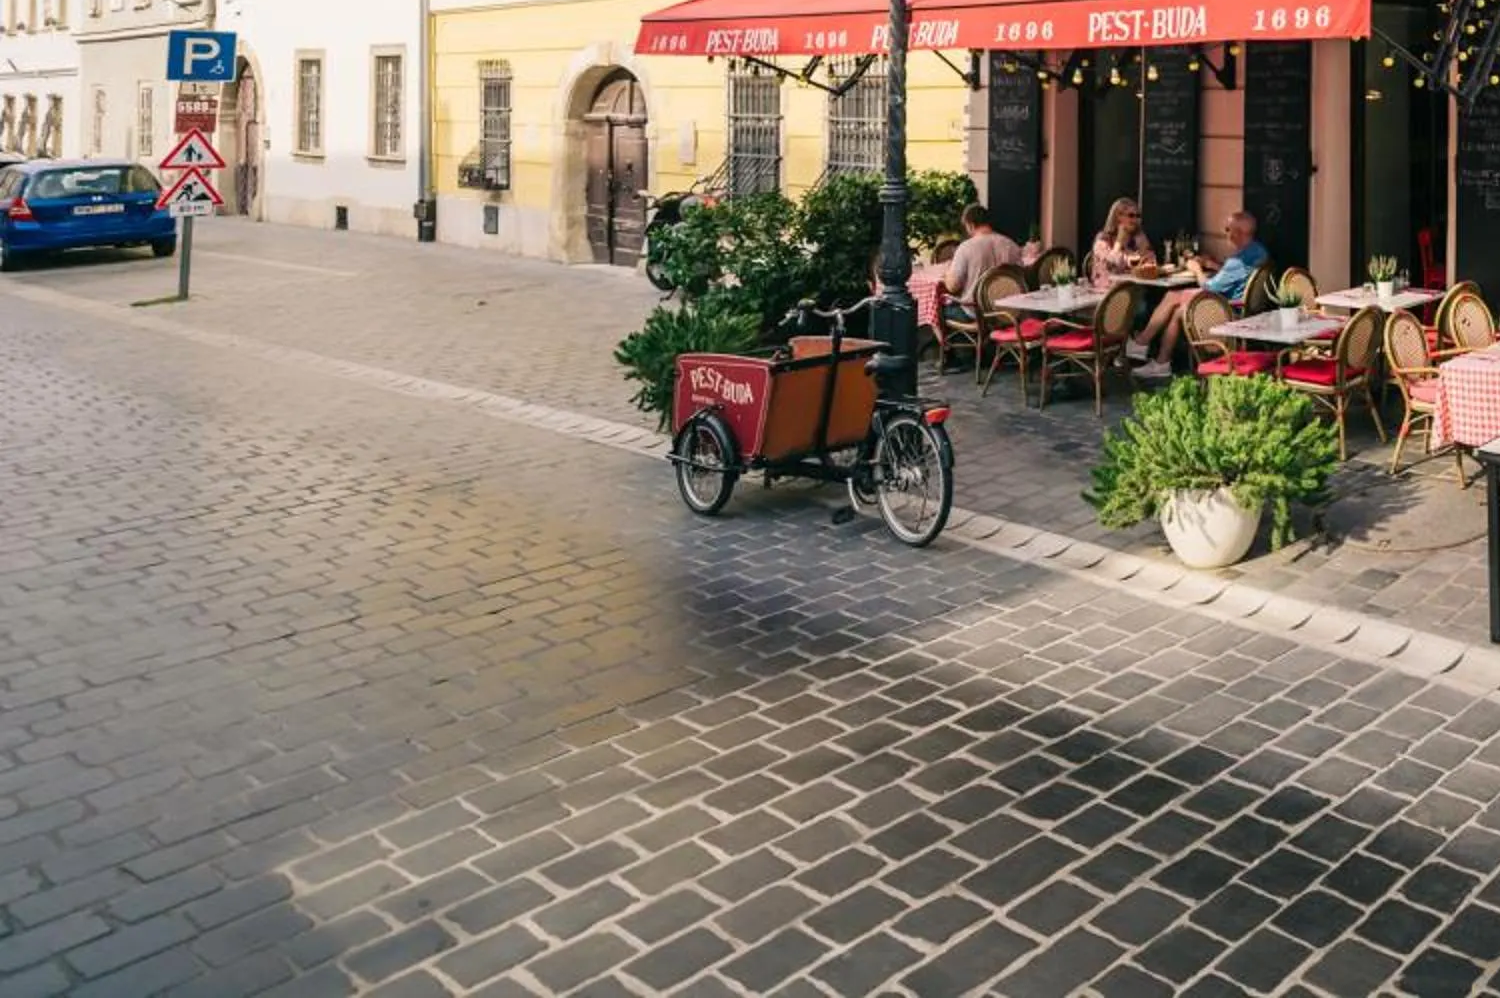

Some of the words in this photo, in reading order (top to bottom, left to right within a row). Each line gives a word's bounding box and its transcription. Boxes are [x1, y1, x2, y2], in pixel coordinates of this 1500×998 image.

[994, 20, 1054, 43] 1696
[1252, 6, 1331, 32] 1696
[184, 38, 221, 75] P
